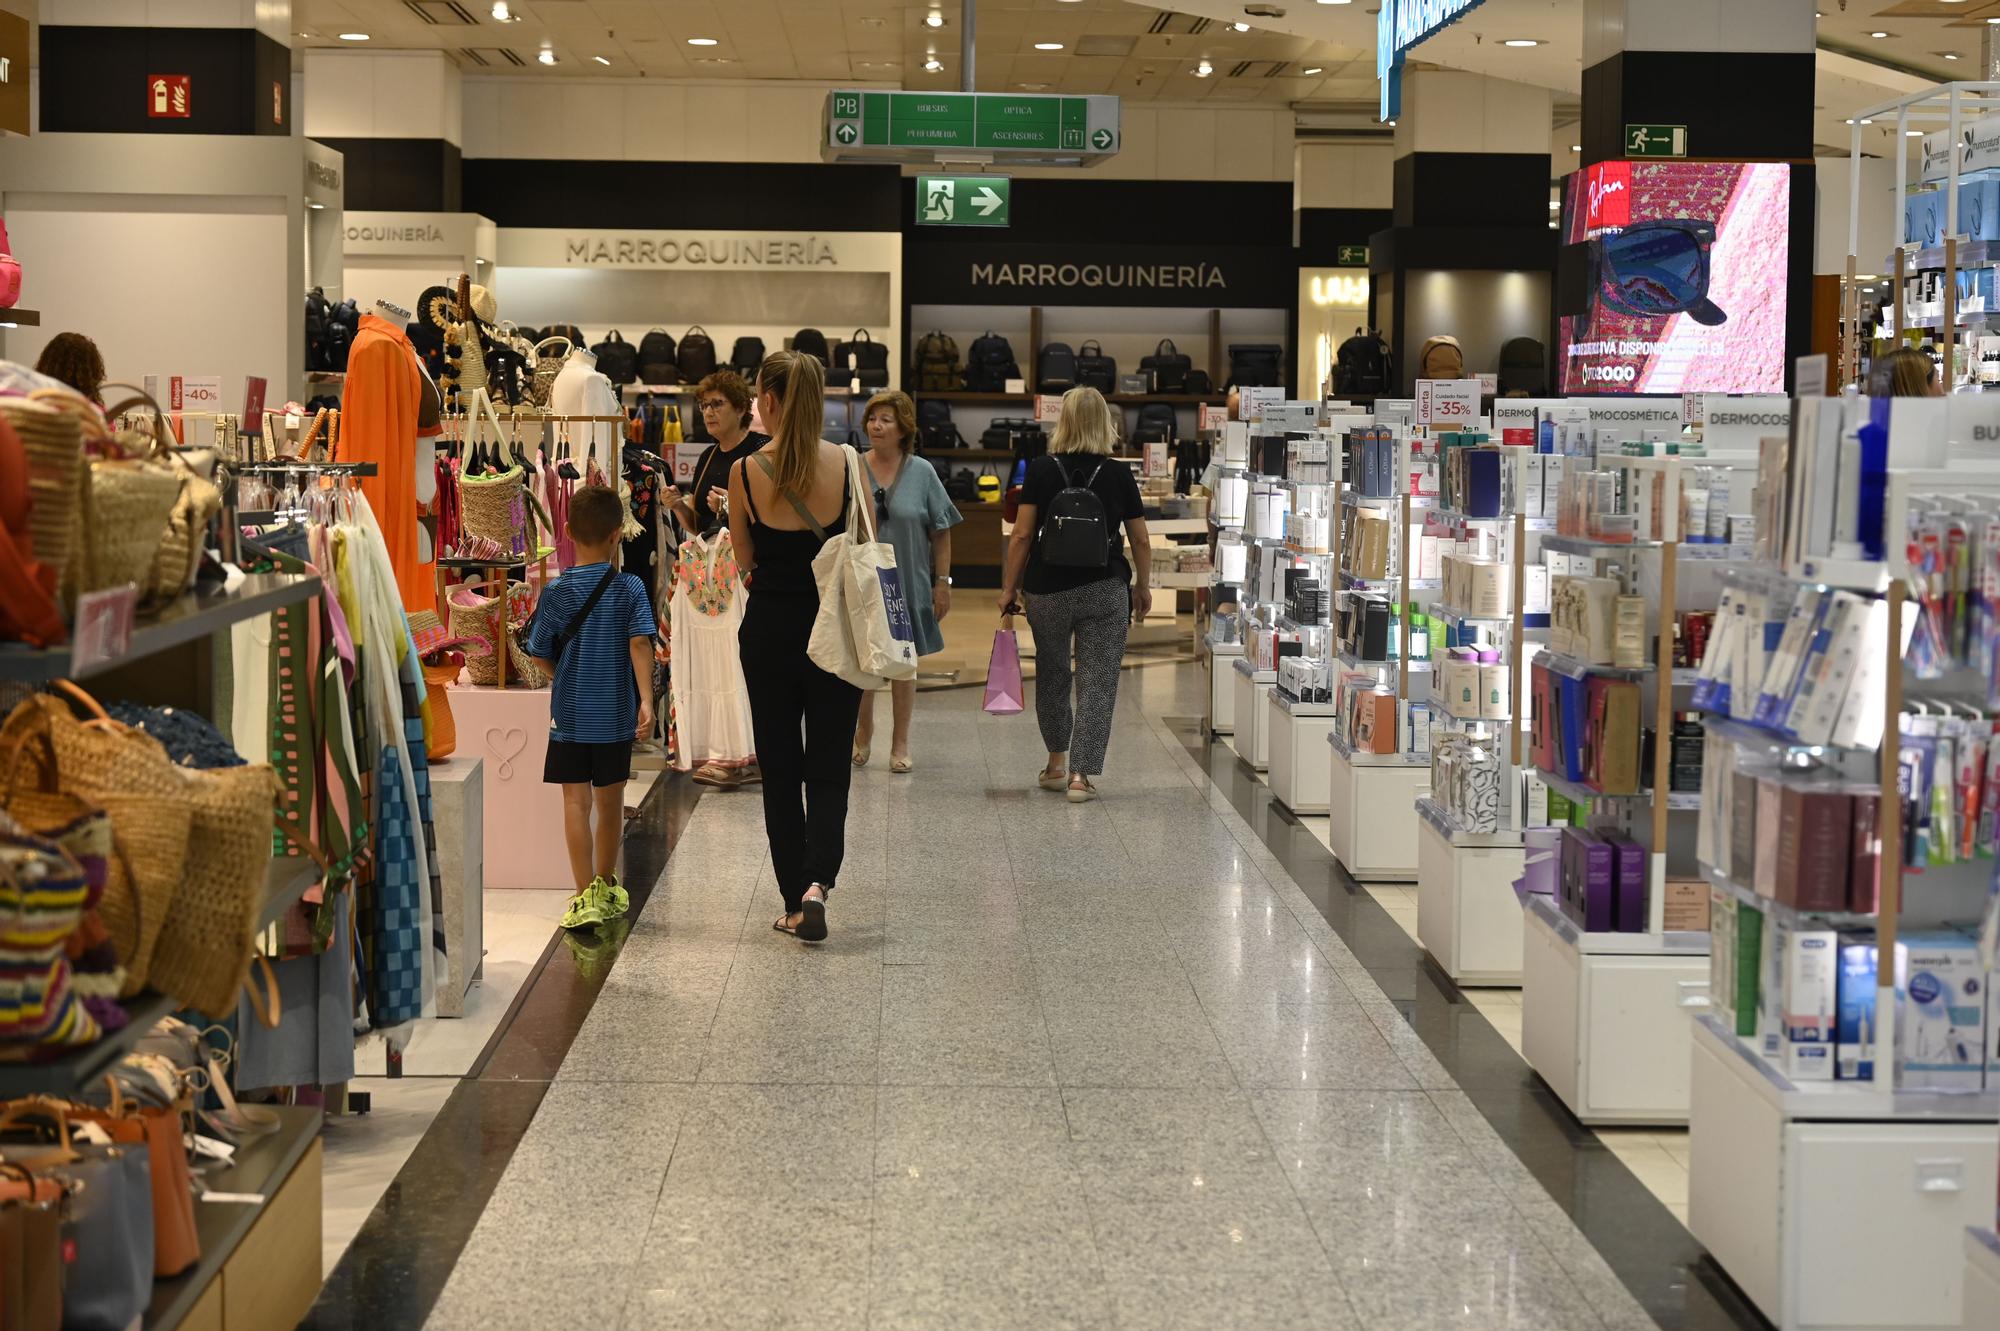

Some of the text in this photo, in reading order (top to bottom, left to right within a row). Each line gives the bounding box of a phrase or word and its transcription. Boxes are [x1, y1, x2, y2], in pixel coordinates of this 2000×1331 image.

[836, 98, 857, 115] PB
[917, 104, 949, 113] BOLSOS
[1004, 106, 1033, 115] OPTICA
[992, 131, 1045, 141] ASCENSORES
[343, 224, 445, 242] OQUINERÍA
[565, 235, 837, 266] MARROQUINERÍA
[971, 261, 1226, 289] MARROQUINERÍA
[184, 389, 218, 401] -40%
[1421, 390, 1430, 418] oferta
[1435, 401, 1471, 415] -35%
